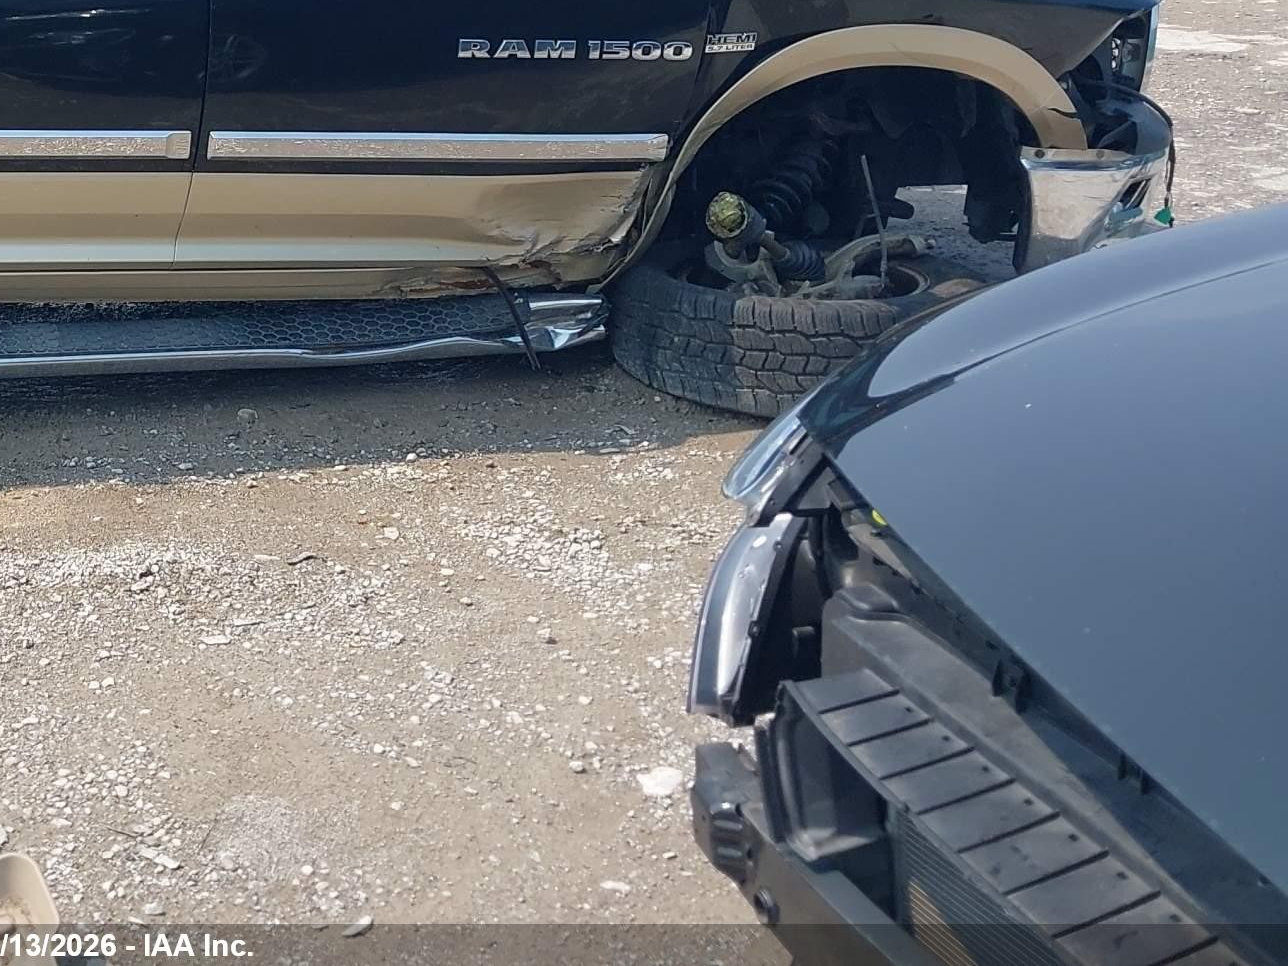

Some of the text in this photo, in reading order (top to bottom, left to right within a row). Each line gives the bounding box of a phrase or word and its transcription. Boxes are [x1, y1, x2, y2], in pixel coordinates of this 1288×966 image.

[707, 33, 757, 45] HEMI
[457, 39, 693, 61] RAM 1500
[725, 43, 754, 51] LITER
